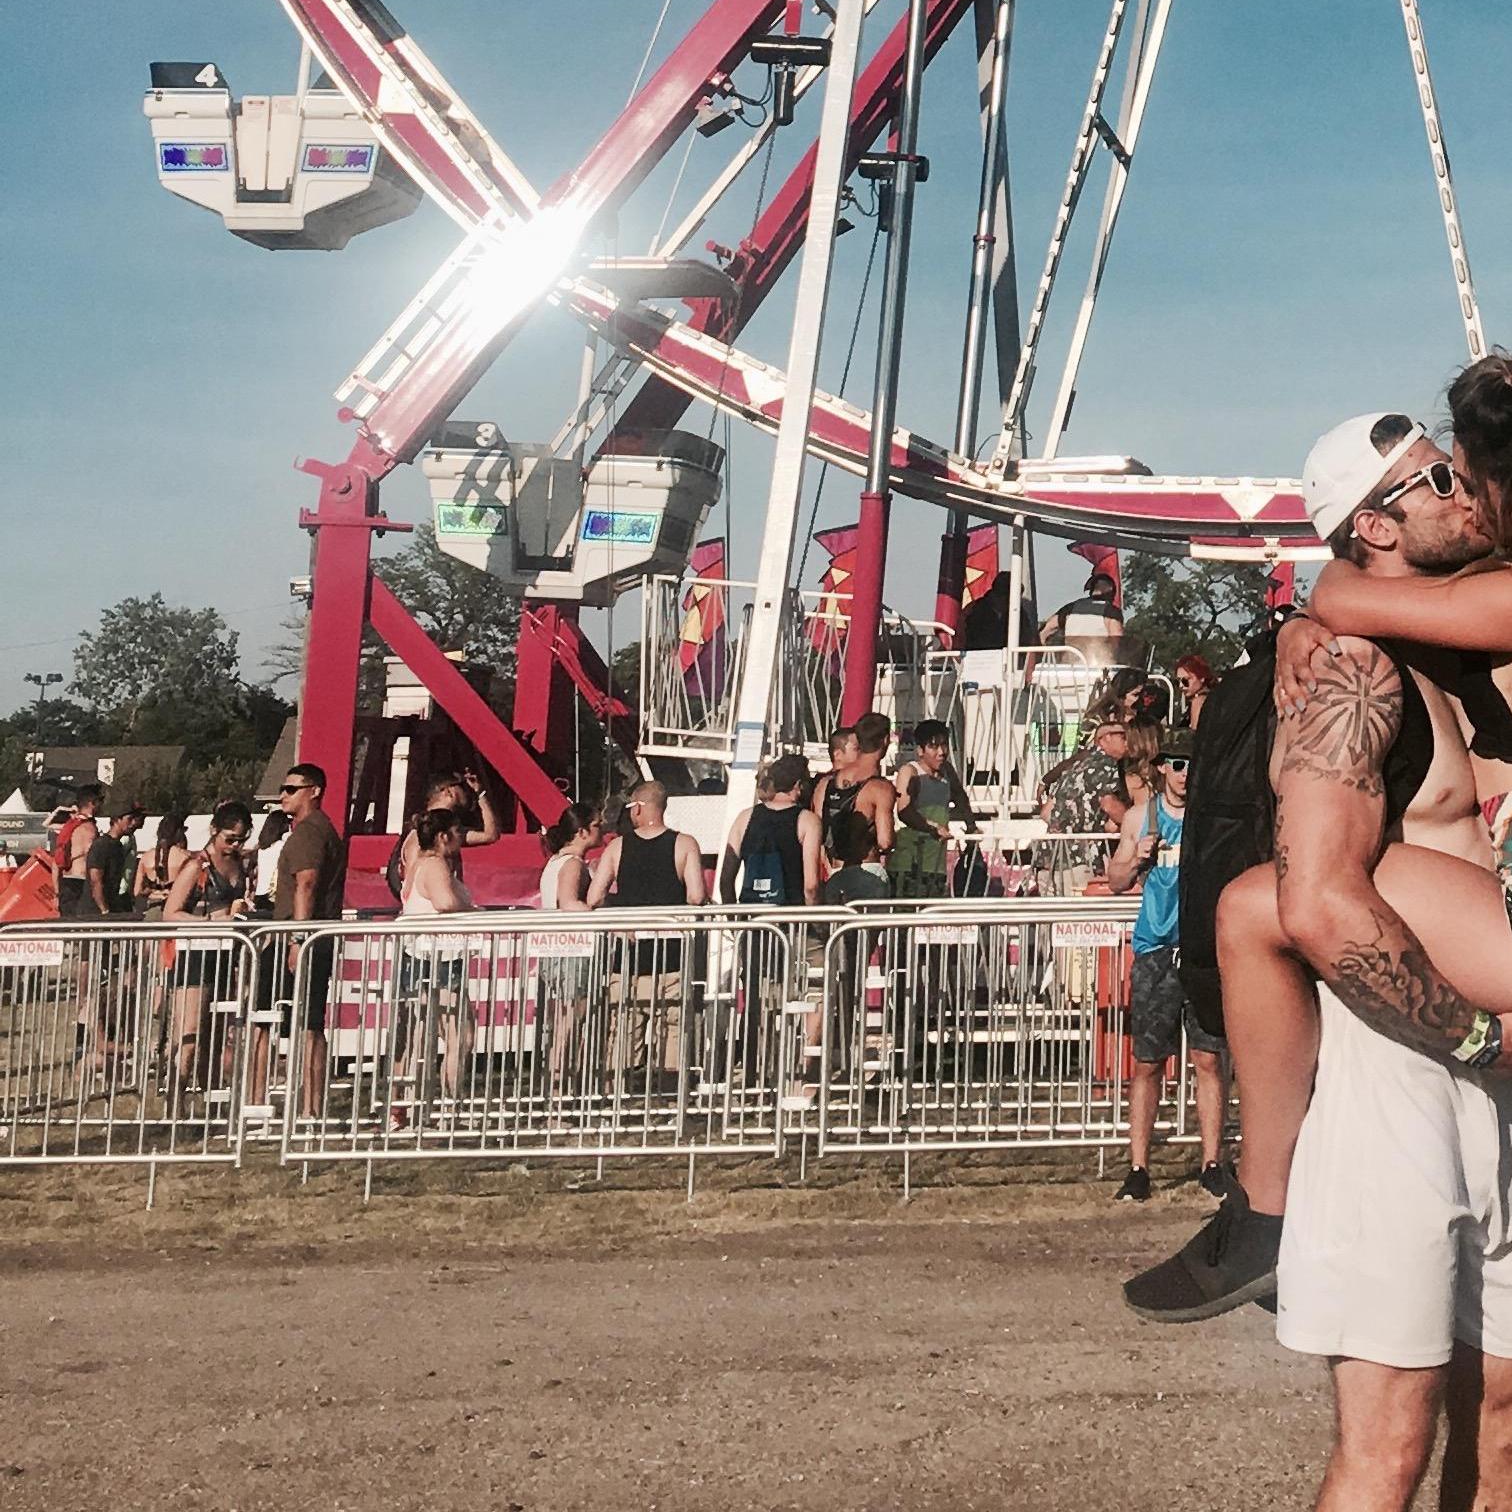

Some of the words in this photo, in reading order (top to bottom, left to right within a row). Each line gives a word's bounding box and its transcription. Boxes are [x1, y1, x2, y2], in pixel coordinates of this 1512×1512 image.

[194, 63, 219, 87] 4
[475, 422, 498, 448] 3
[1056, 922, 1116, 935] NATIONAL
[531, 933, 592, 945] NATIONAL
[0, 942, 60, 954] NATIONAL
